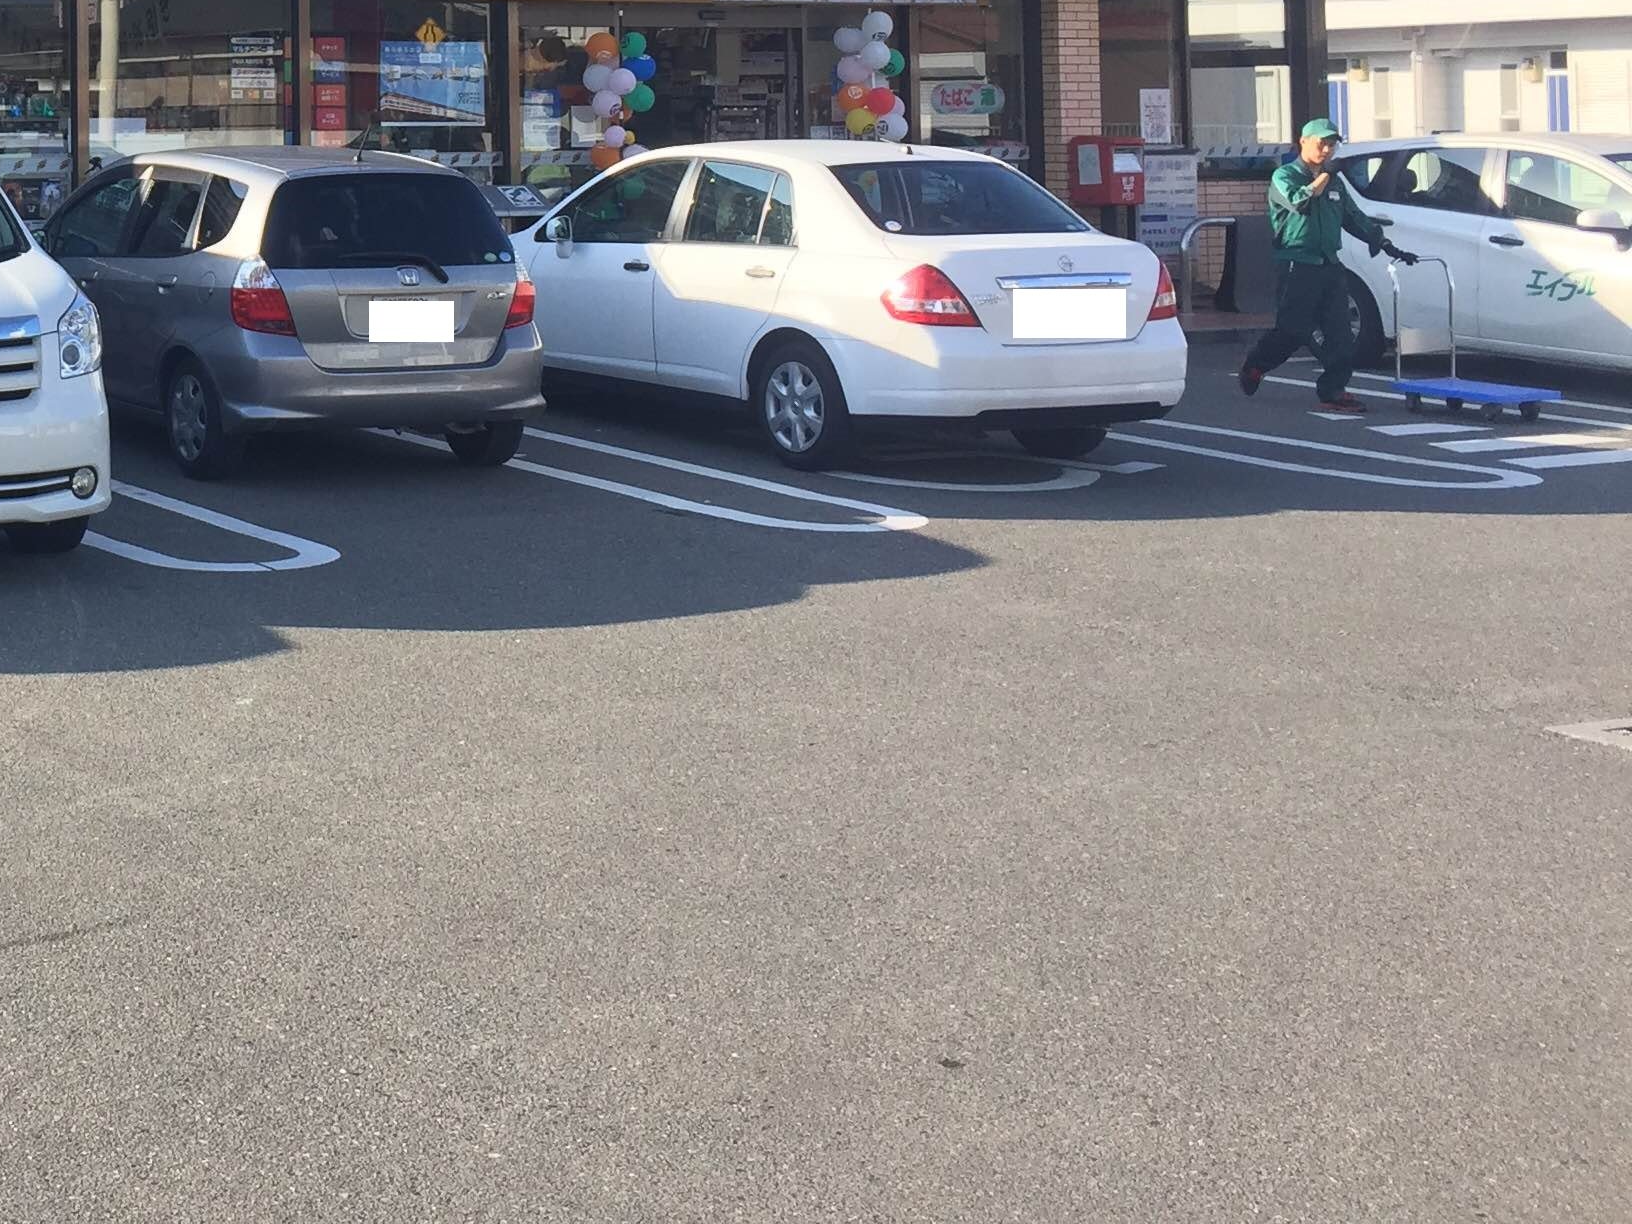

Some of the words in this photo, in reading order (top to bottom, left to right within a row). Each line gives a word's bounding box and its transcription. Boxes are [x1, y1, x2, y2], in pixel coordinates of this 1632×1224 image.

[940, 88, 975, 106] たばこ
[1526, 269, 1597, 301] エイブル
